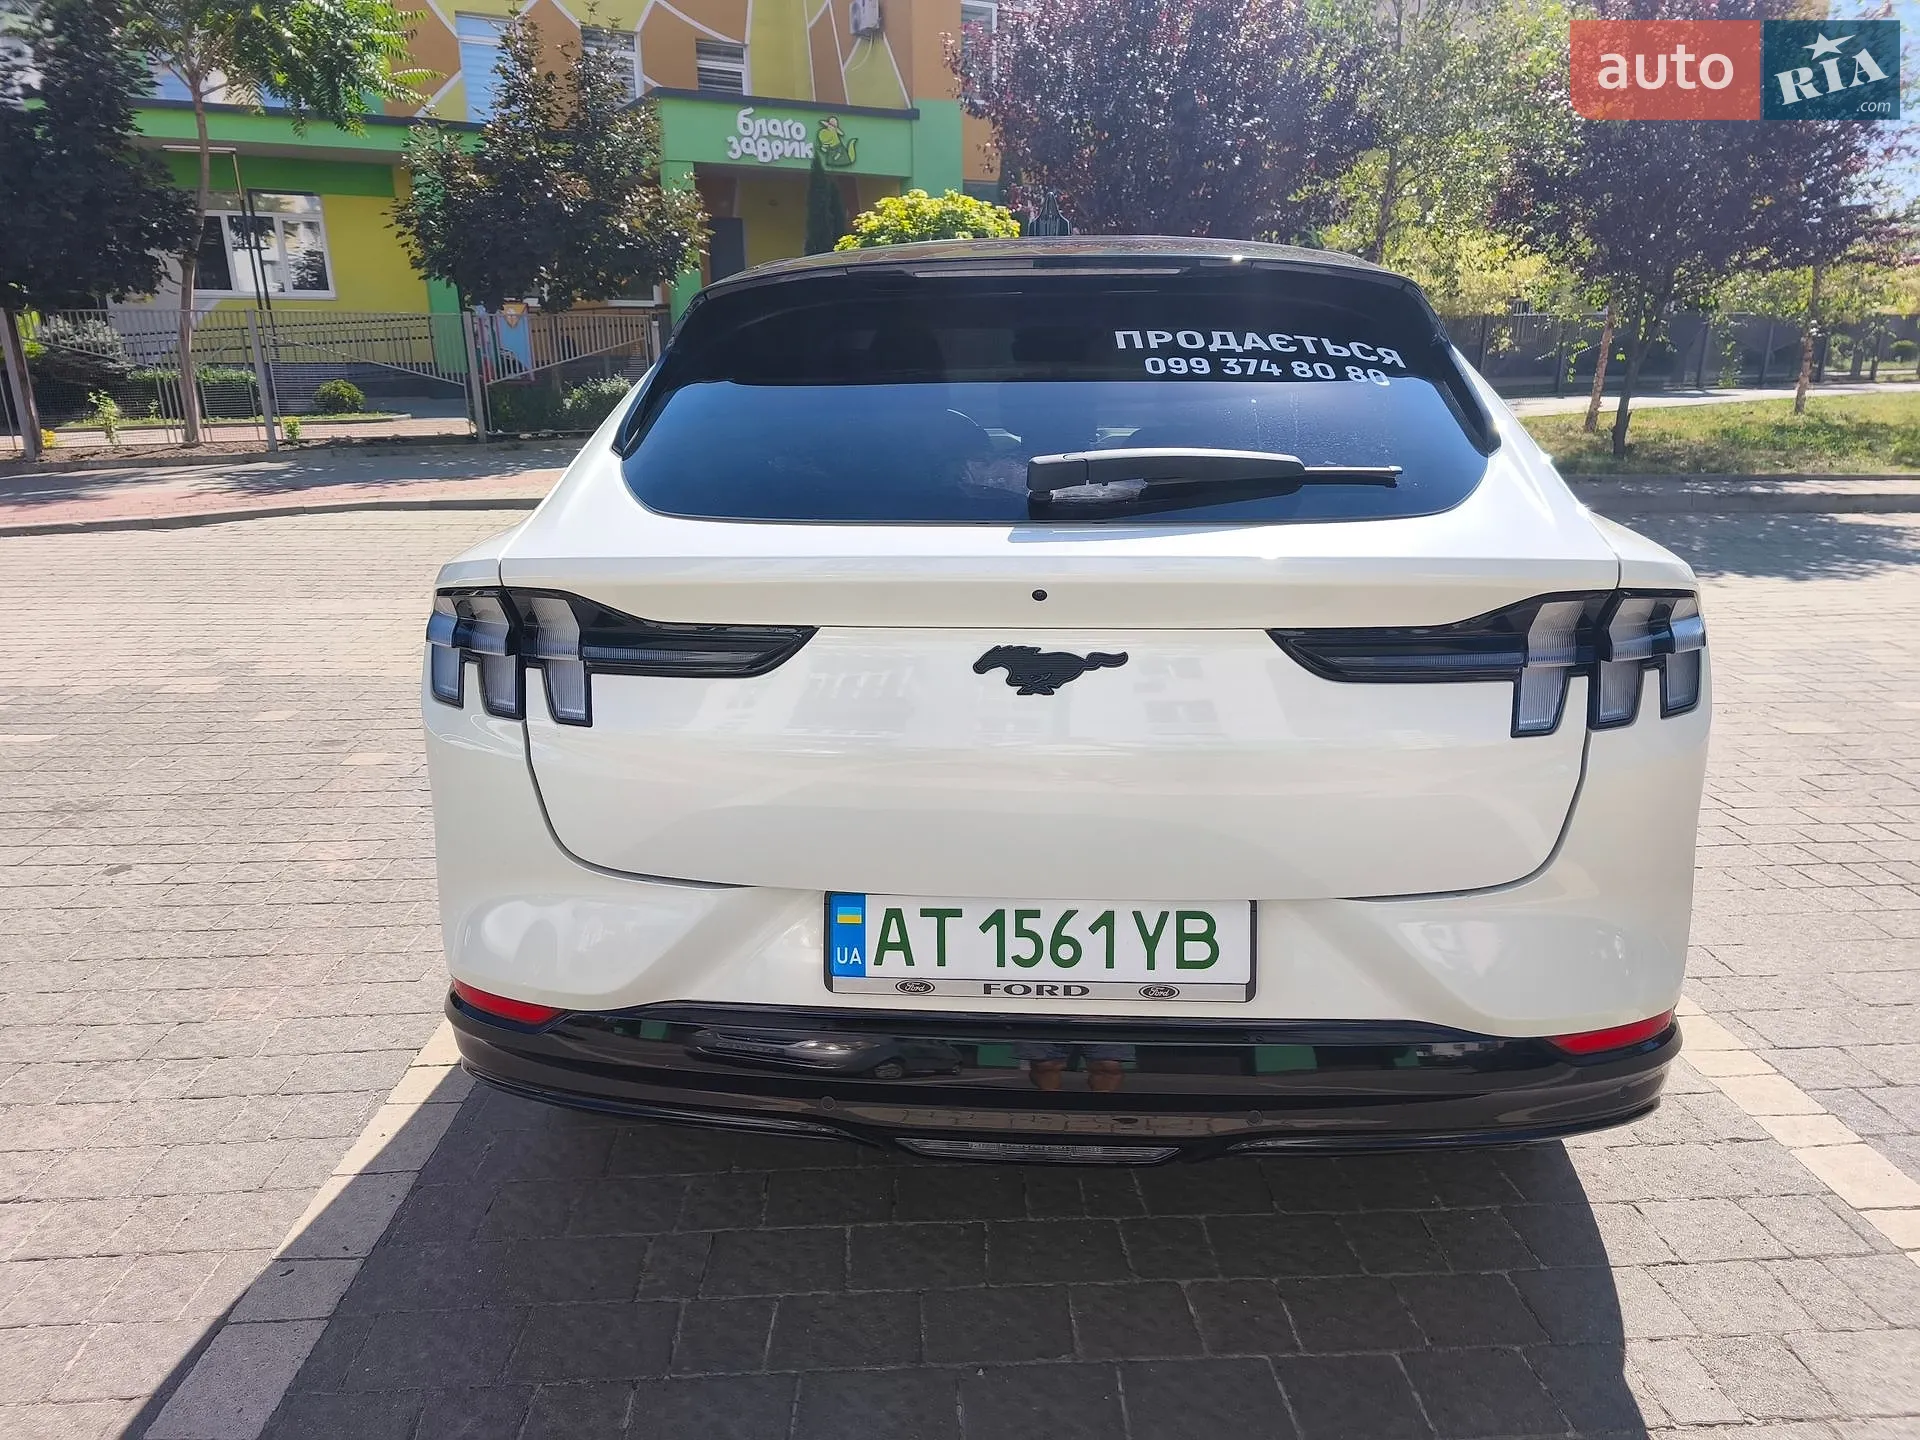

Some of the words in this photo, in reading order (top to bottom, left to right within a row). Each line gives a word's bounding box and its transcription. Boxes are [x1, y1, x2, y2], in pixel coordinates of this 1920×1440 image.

[736, 107, 807, 139] благо
[726, 136, 815, 163] заврик
[1114, 330, 1407, 369] ПРОДАЄТЬСЯ
[1144, 357, 1211, 375] 099
[1220, 358, 1282, 377] 374
[1290, 361, 1337, 380] 80
[1345, 365, 1391, 386] 80
[873, 908, 963, 967] AT
[978, 909, 1115, 969] 1561
[1132, 910, 1220, 970] YB
[837, 947, 862, 965] UA
[983, 983, 1091, 997] FORD
